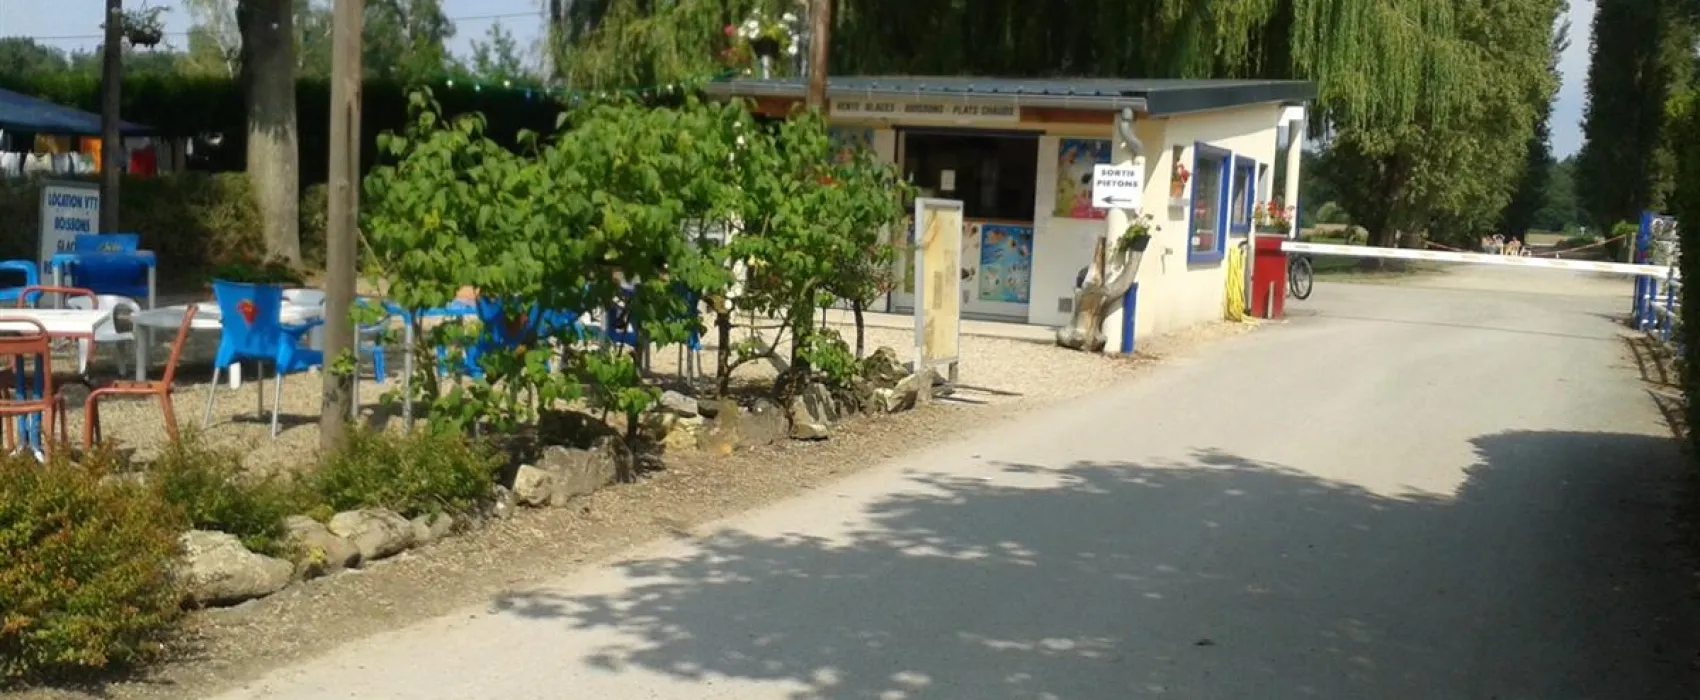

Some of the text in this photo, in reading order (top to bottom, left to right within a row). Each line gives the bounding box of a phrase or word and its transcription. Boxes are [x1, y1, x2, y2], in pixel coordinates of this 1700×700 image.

[952, 104, 977, 115] PLATS
[1101, 168, 1135, 177] SORTIE
[48, 193, 82, 208] LOCATION
[54, 216, 90, 232] BOISSONS
